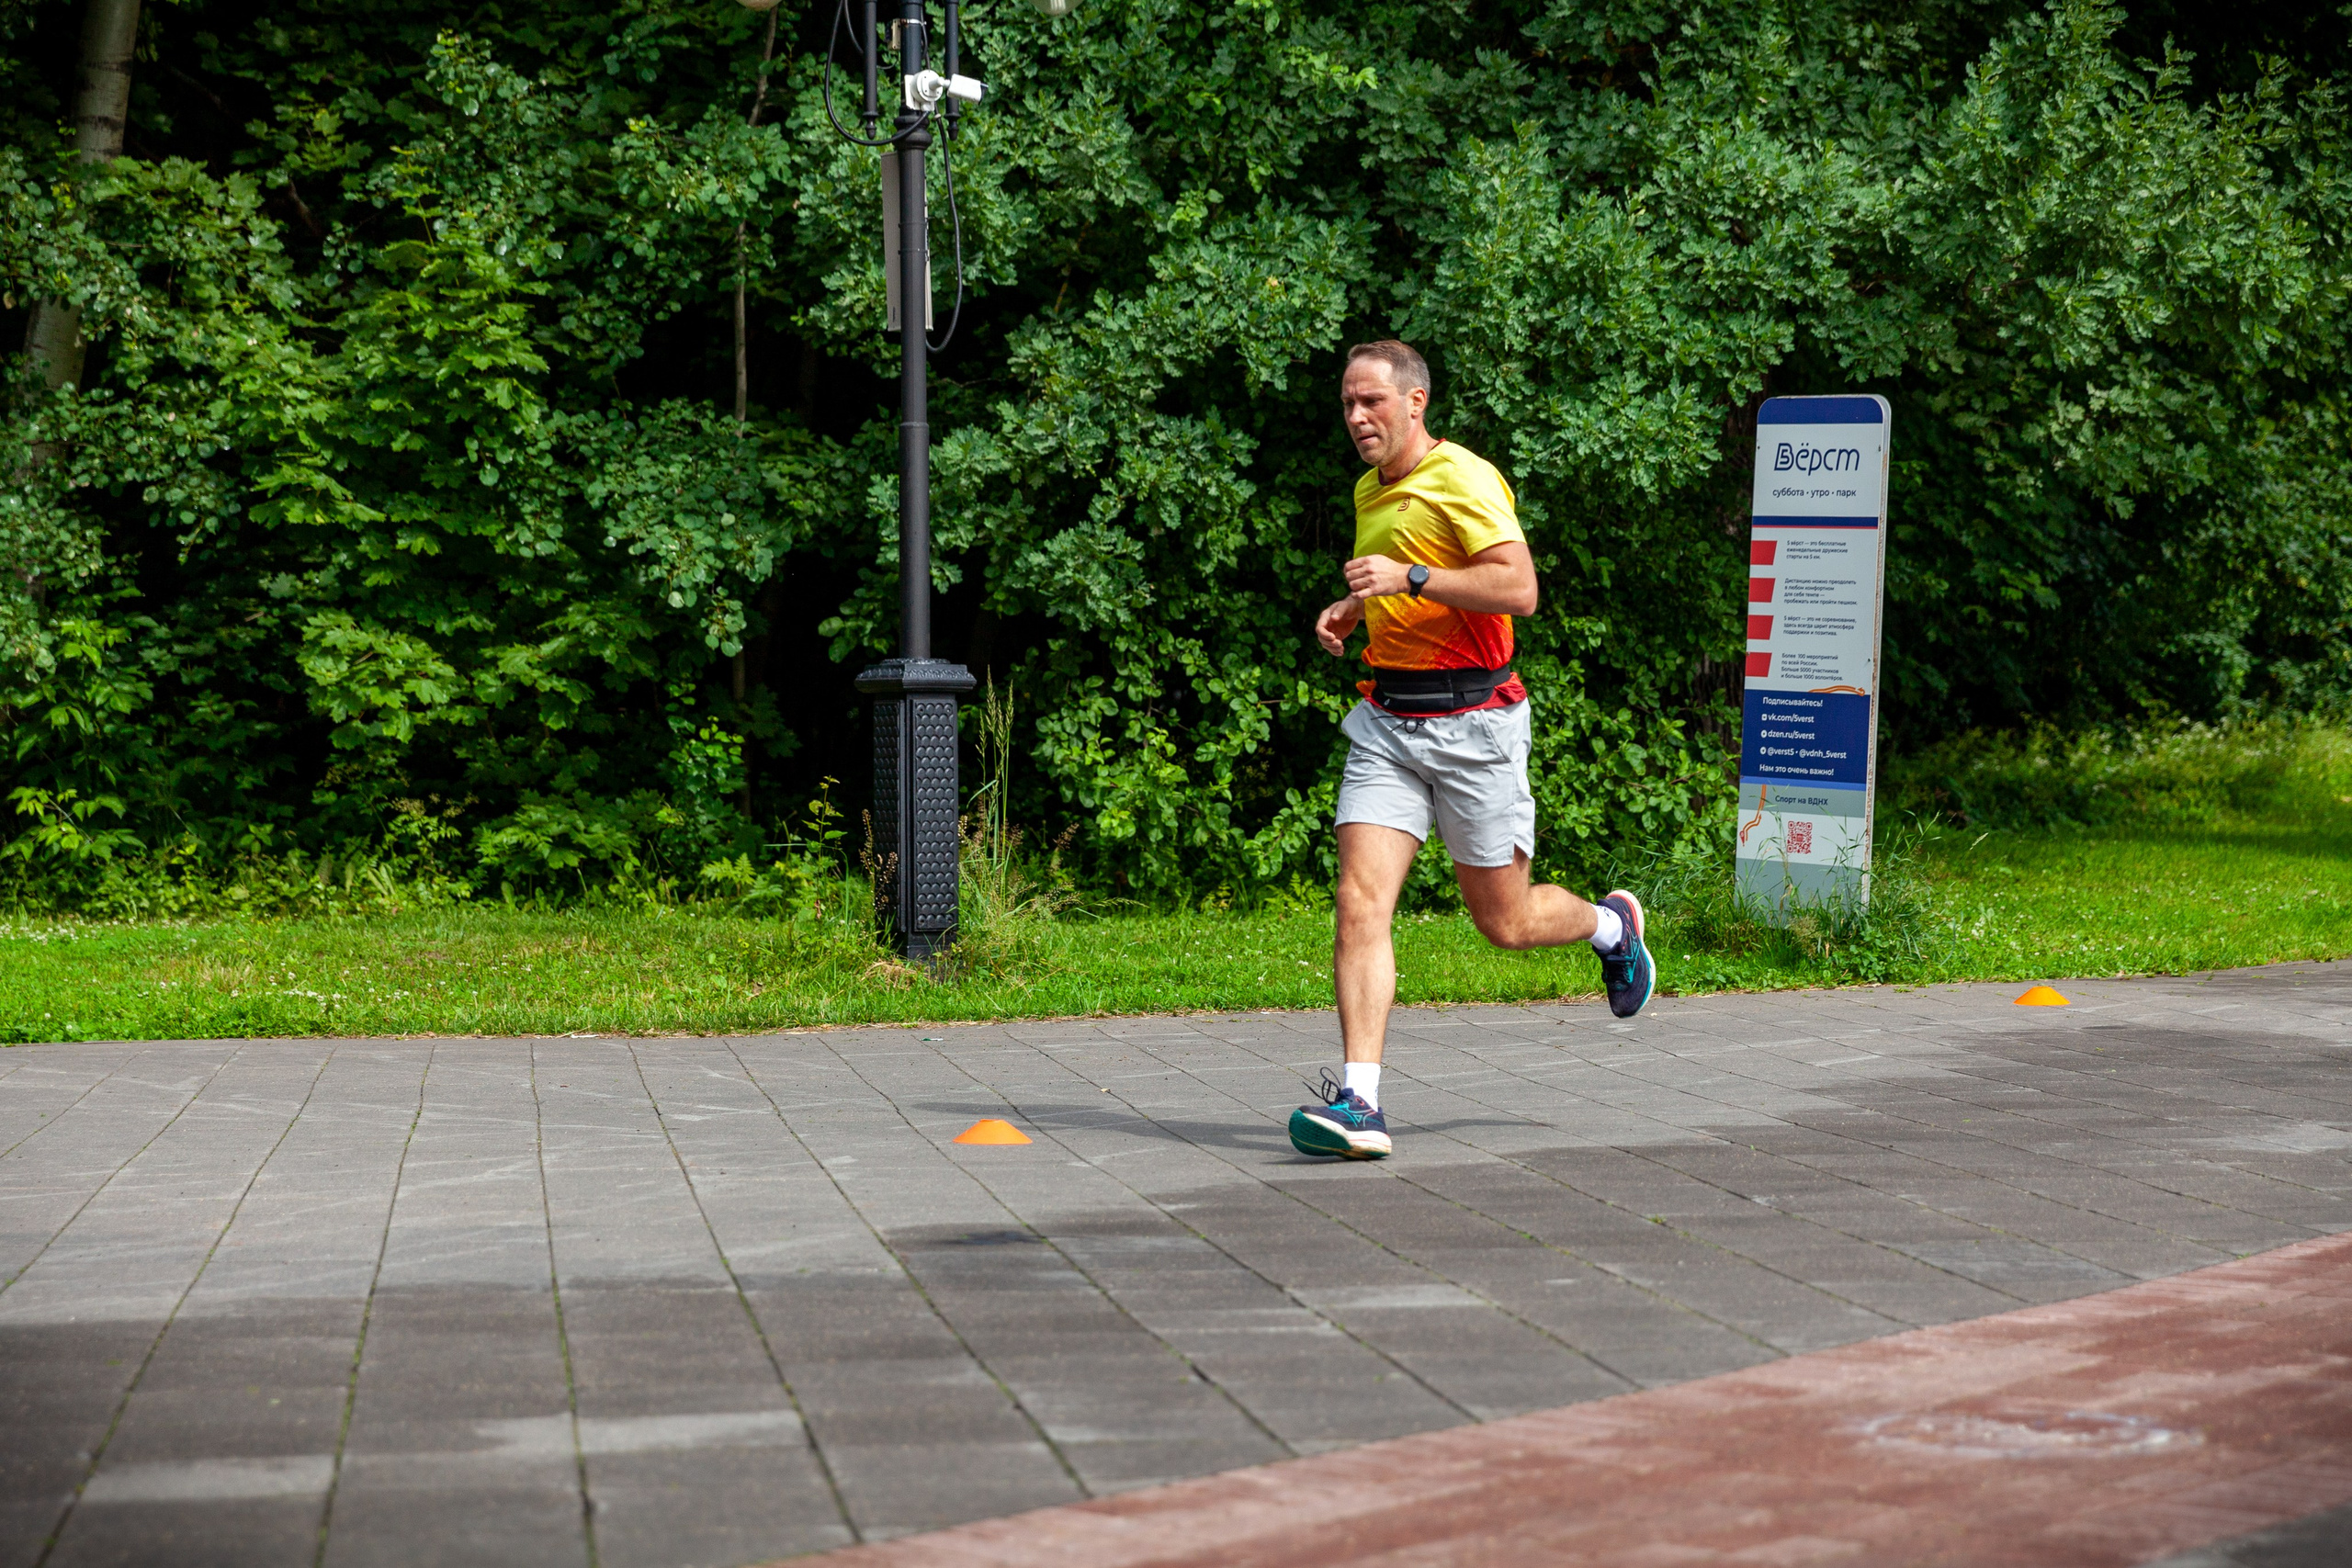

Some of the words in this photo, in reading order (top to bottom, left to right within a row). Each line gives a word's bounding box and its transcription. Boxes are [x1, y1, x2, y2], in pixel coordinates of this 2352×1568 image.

[1772, 488, 1804, 499] суббота
[1810, 490, 1830, 499] утро
[1837, 490, 1857, 499] парк
[1762, 697, 1824, 707] Подписывайтесь!
[1769, 713, 1815, 723] vk.com/5verst
[1768, 730, 1815, 740] dzen.ru/5verst
[1767, 747, 1794, 756] @verst5
[1799, 749, 1847, 759] @vdnh_5verst
[1809, 768, 1835, 776] важно!
[1775, 795, 1796, 805] Спорт
[1808, 797, 1828, 806] ВДНХ
